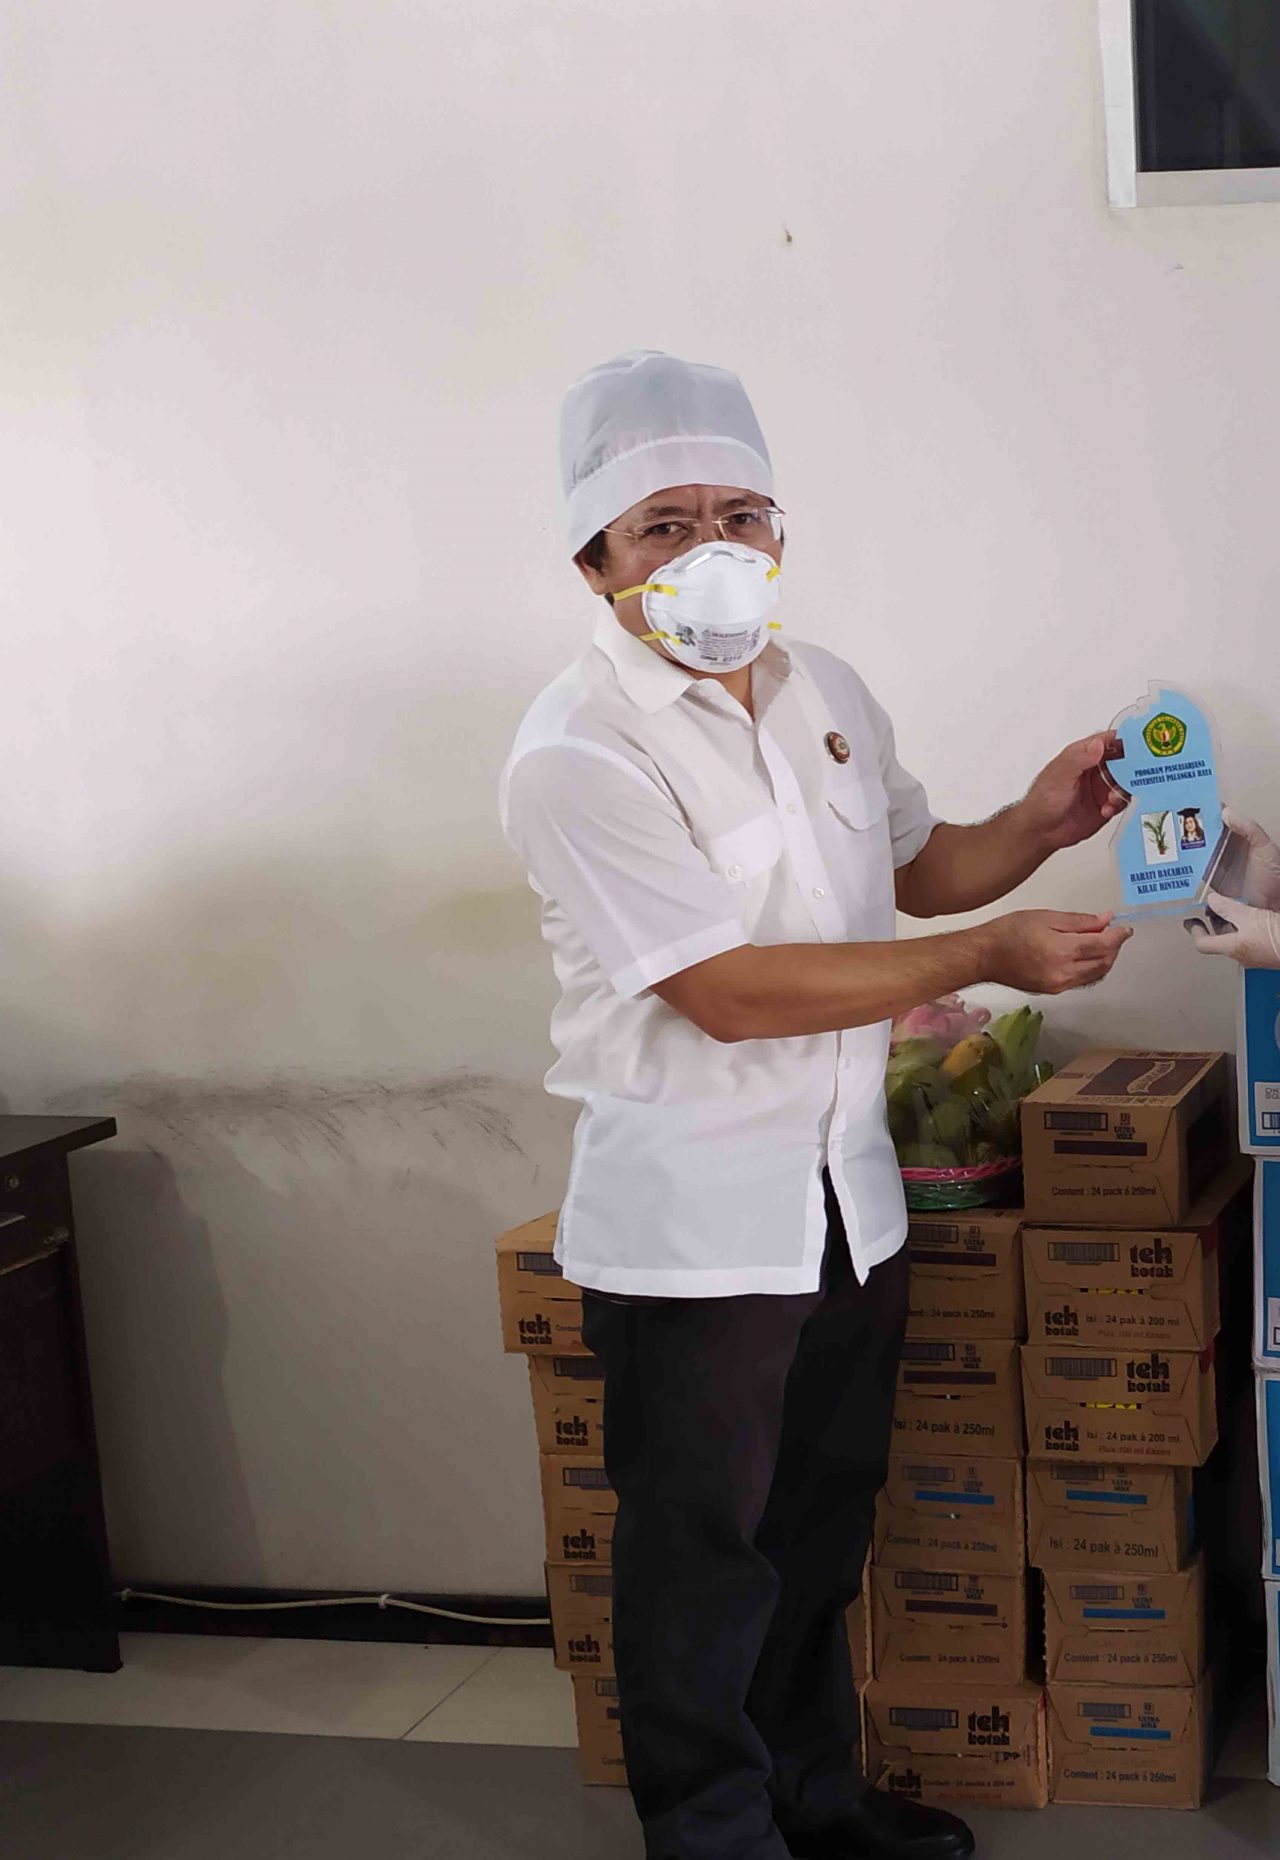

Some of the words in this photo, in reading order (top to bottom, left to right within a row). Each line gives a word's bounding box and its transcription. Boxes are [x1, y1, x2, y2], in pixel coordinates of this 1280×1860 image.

[1134, 765, 1164, 777] PROGRAM
[1130, 776, 1165, 787] UNIVERSITAS
[1166, 771, 1196, 782] PALANGKA
[1160, 879, 1190, 892] BINTANG
[1103, 1187, 1122, 1198] pack
[1130, 1238, 1173, 1264] teh
[1130, 1265, 1174, 1278] kotak
[1044, 1305, 1079, 1326] teh
[1105, 1315, 1117, 1324] 24
[1120, 1315, 1137, 1326] pak
[518, 1314, 551, 1334] teh
[1045, 1325, 1079, 1336] kotak
[1126, 1353, 1170, 1380] teh
[1127, 1380, 1171, 1393] kotak
[555, 1415, 587, 1436] teh
[931, 1422, 949, 1434] pak
[963, 1423, 995, 1436] 250ml
[1073, 1538, 1087, 1550] 24
[1090, 1541, 1111, 1554] pak
[1125, 1543, 1159, 1559] 250ml
[1120, 1654, 1142, 1665] pack
[968, 1706, 1010, 1733] teh
[968, 1732, 1010, 1745] kotak
